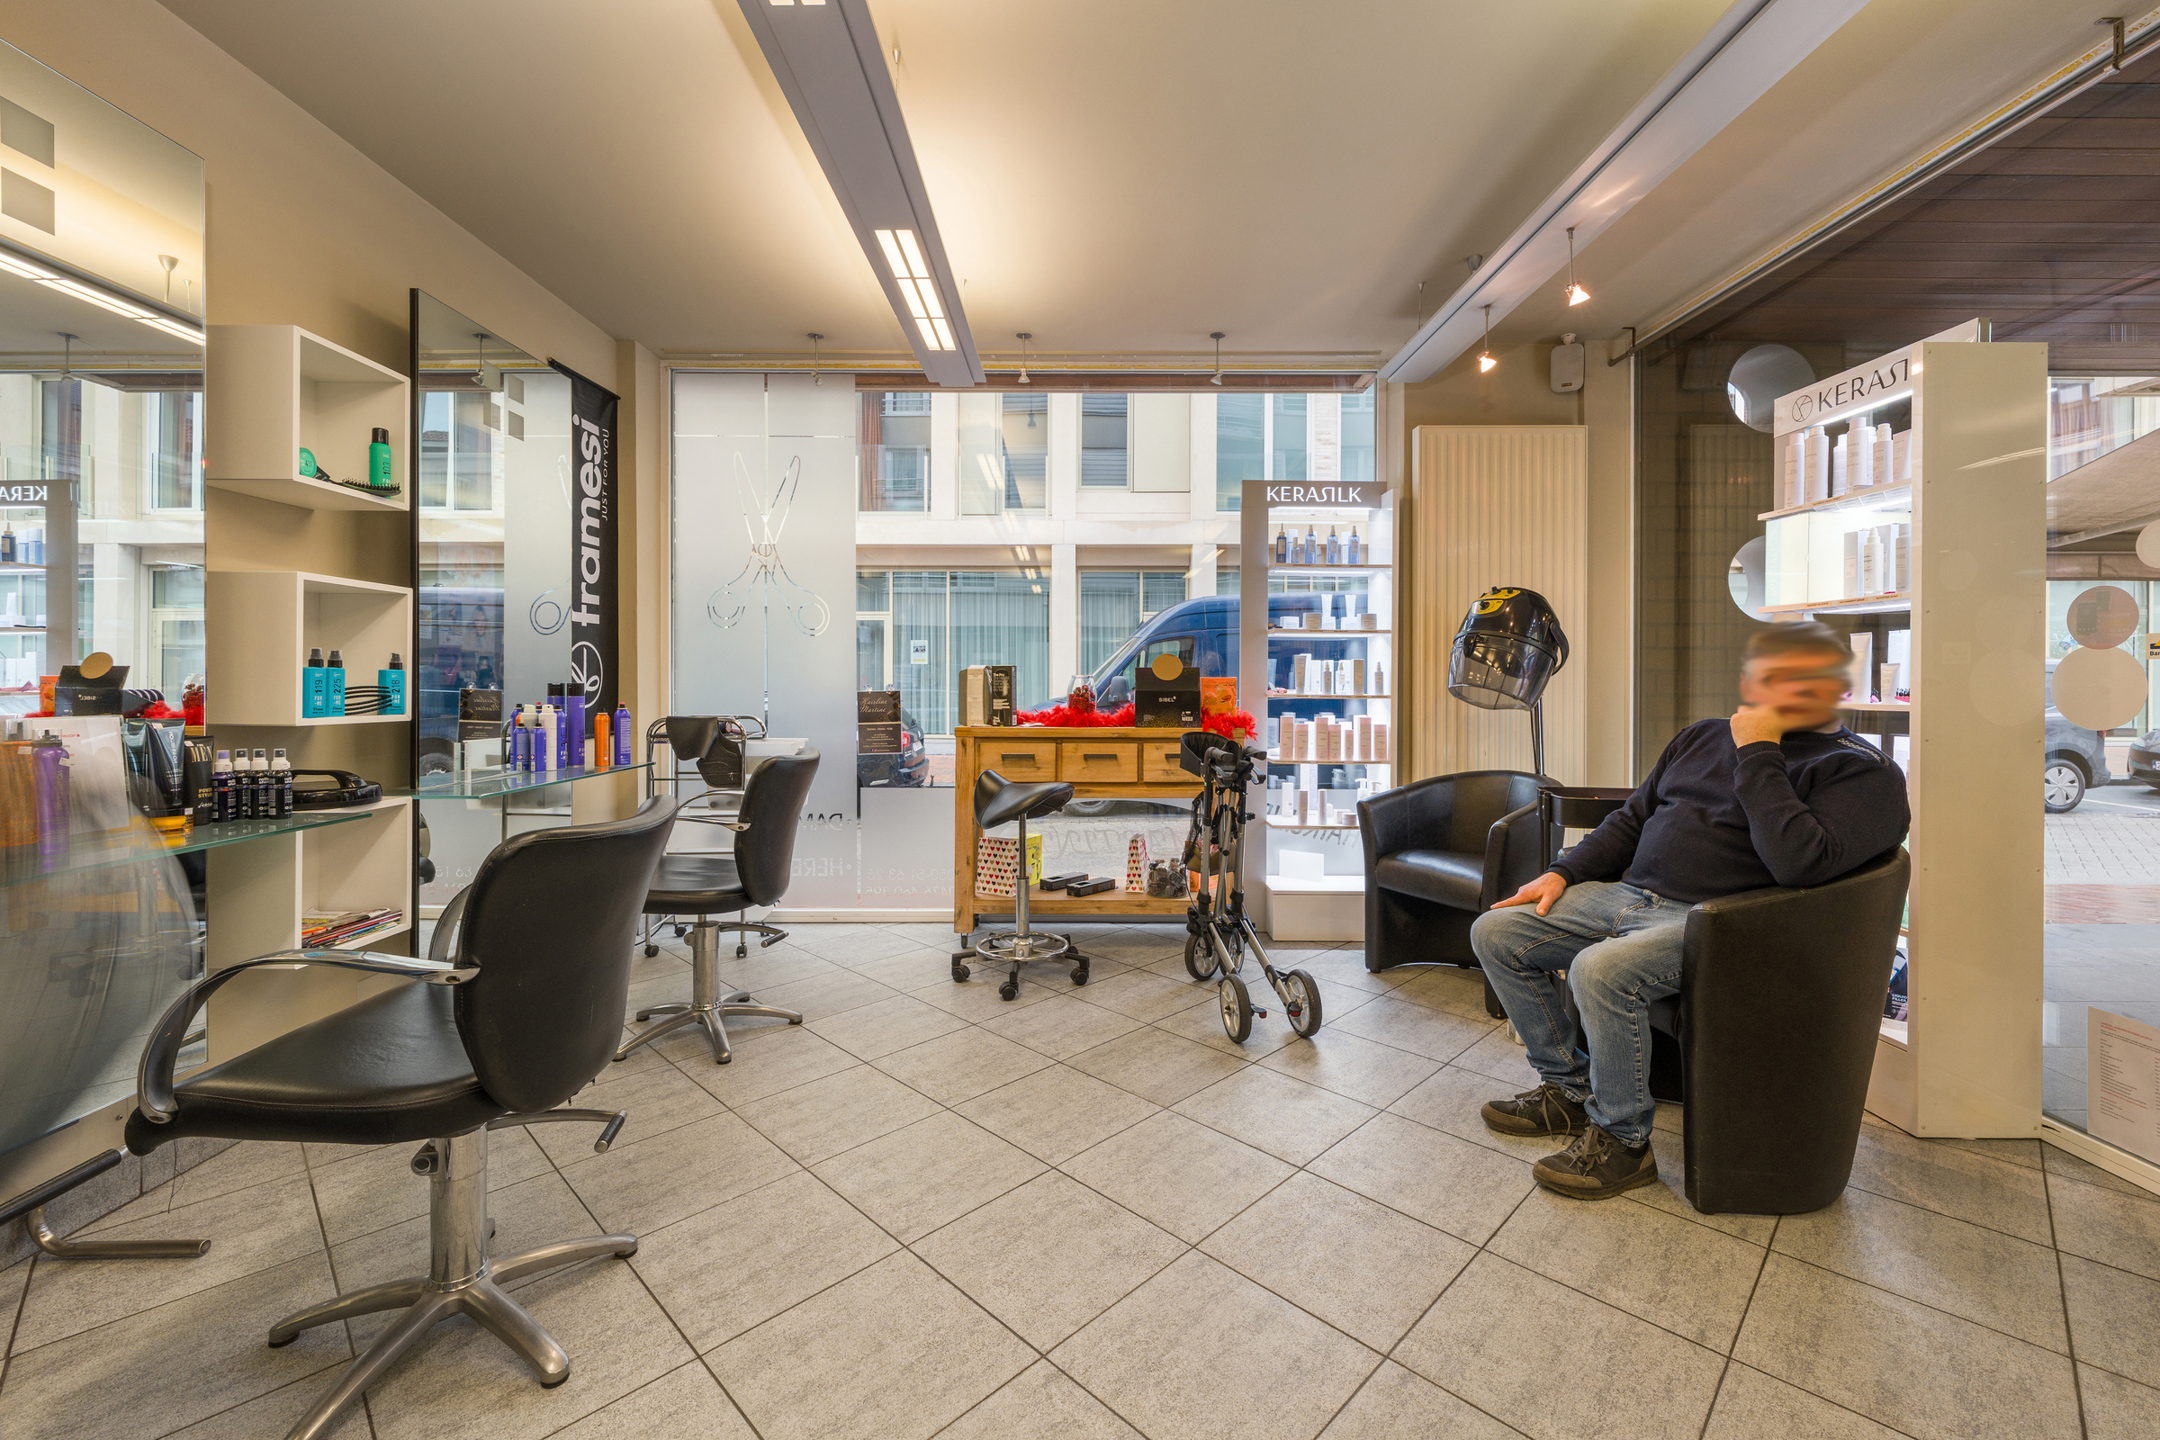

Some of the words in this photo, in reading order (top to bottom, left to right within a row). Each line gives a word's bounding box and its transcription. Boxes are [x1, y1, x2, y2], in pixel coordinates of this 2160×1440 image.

[1818, 358, 1908, 412] KERASI
[382, 461, 391, 475] 103
[1266, 486, 1362, 503] KERASILK
[571, 414, 602, 627] framesi
[314, 679, 323, 694] 119
[333, 678, 342, 694] 225
[391, 679, 400, 693] 218
[190, 745, 213, 763] MEN
